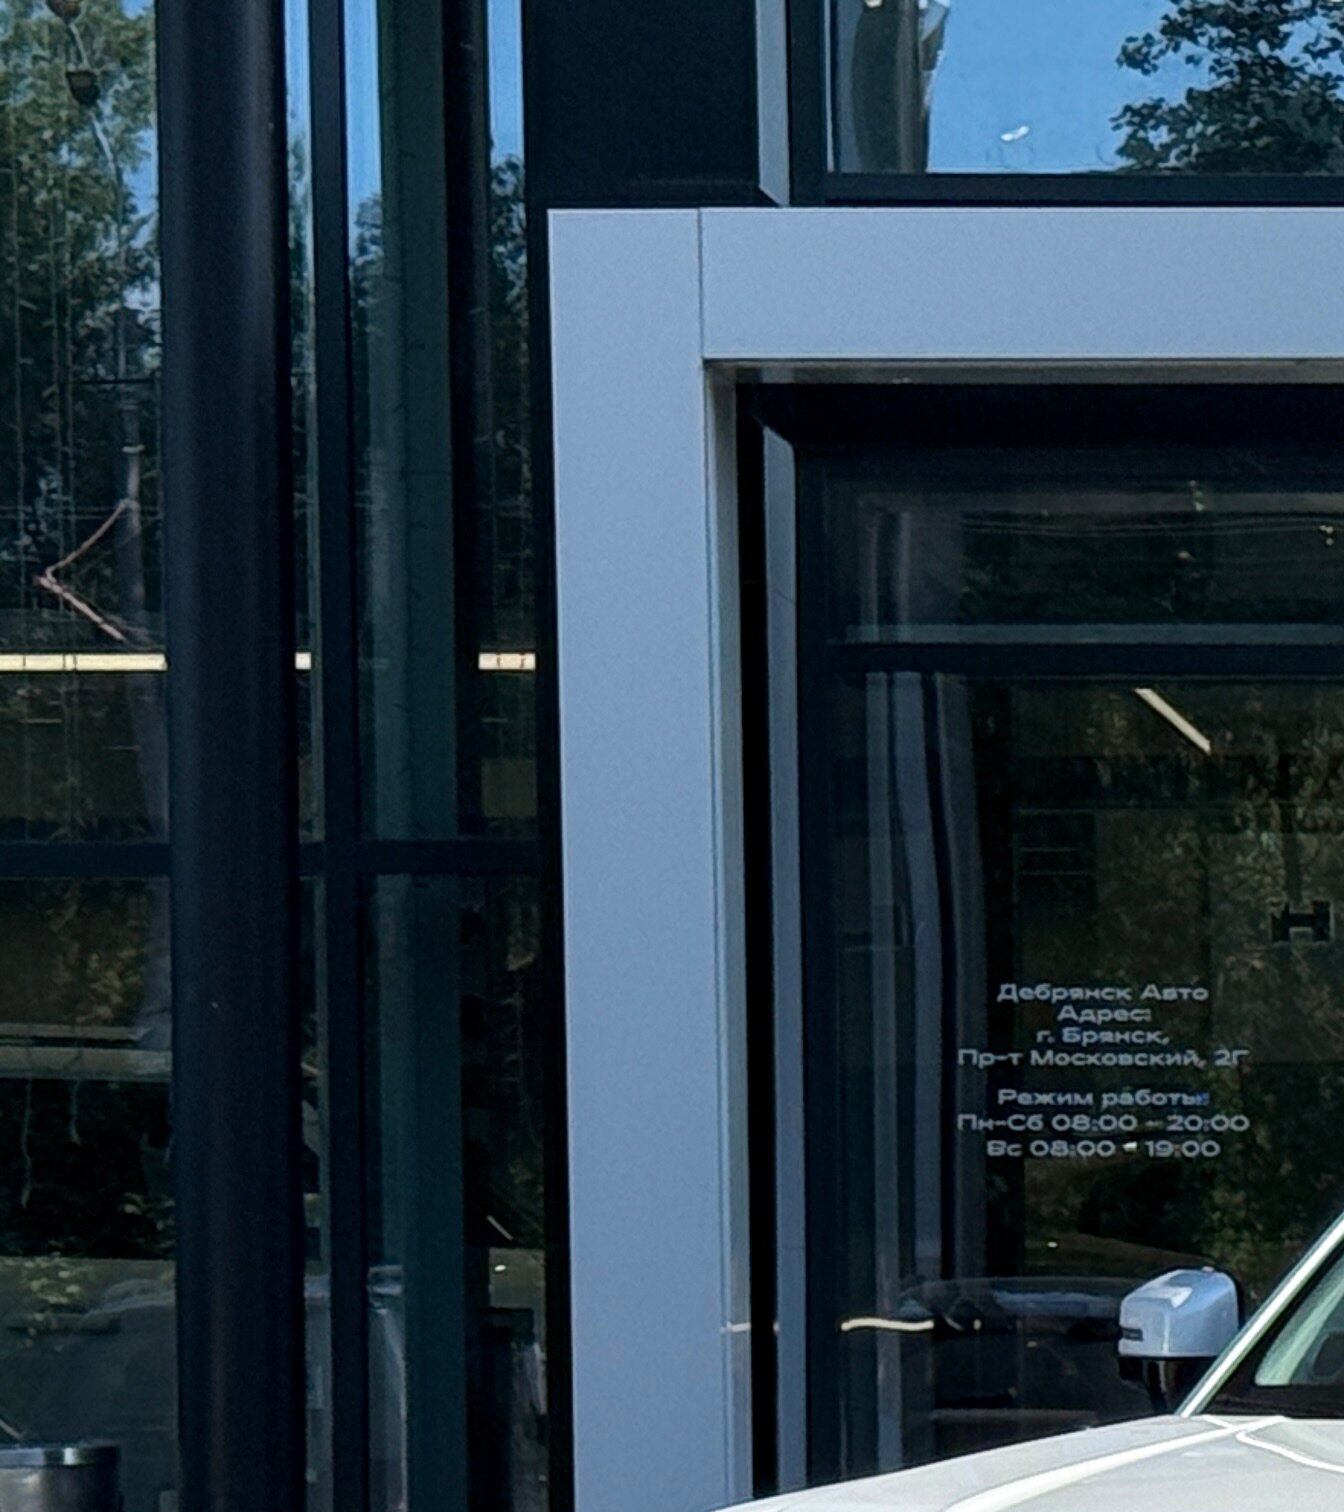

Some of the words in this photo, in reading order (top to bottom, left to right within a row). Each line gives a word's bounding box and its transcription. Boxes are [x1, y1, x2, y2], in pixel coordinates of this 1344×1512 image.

[997, 984, 1132, 1004] Дебрянск
[1140, 984, 1209, 1001] Авто
[1057, 1006, 1152, 1023] Адрес:
[1036, 1030, 1055, 1044] г.
[1062, 1027, 1170, 1046] Брянск,
[958, 1049, 1023, 1068] Пр-т
[1030, 1049, 1206, 1069] Московский,
[1214, 1048, 1250, 1066] 2Г
[997, 1089, 1093, 1106] Режим
[1102, 1088, 1210, 1110] работы:
[957, 1114, 1044, 1132] Пн-Сб
[1051, 1115, 1138, 1132] 08:00
[1165, 1115, 1250, 1132] 20:00
[986, 1140, 1022, 1157] Вс
[1030, 1140, 1116, 1157] 08:00
[1145, 1140, 1221, 1157] 19:00
